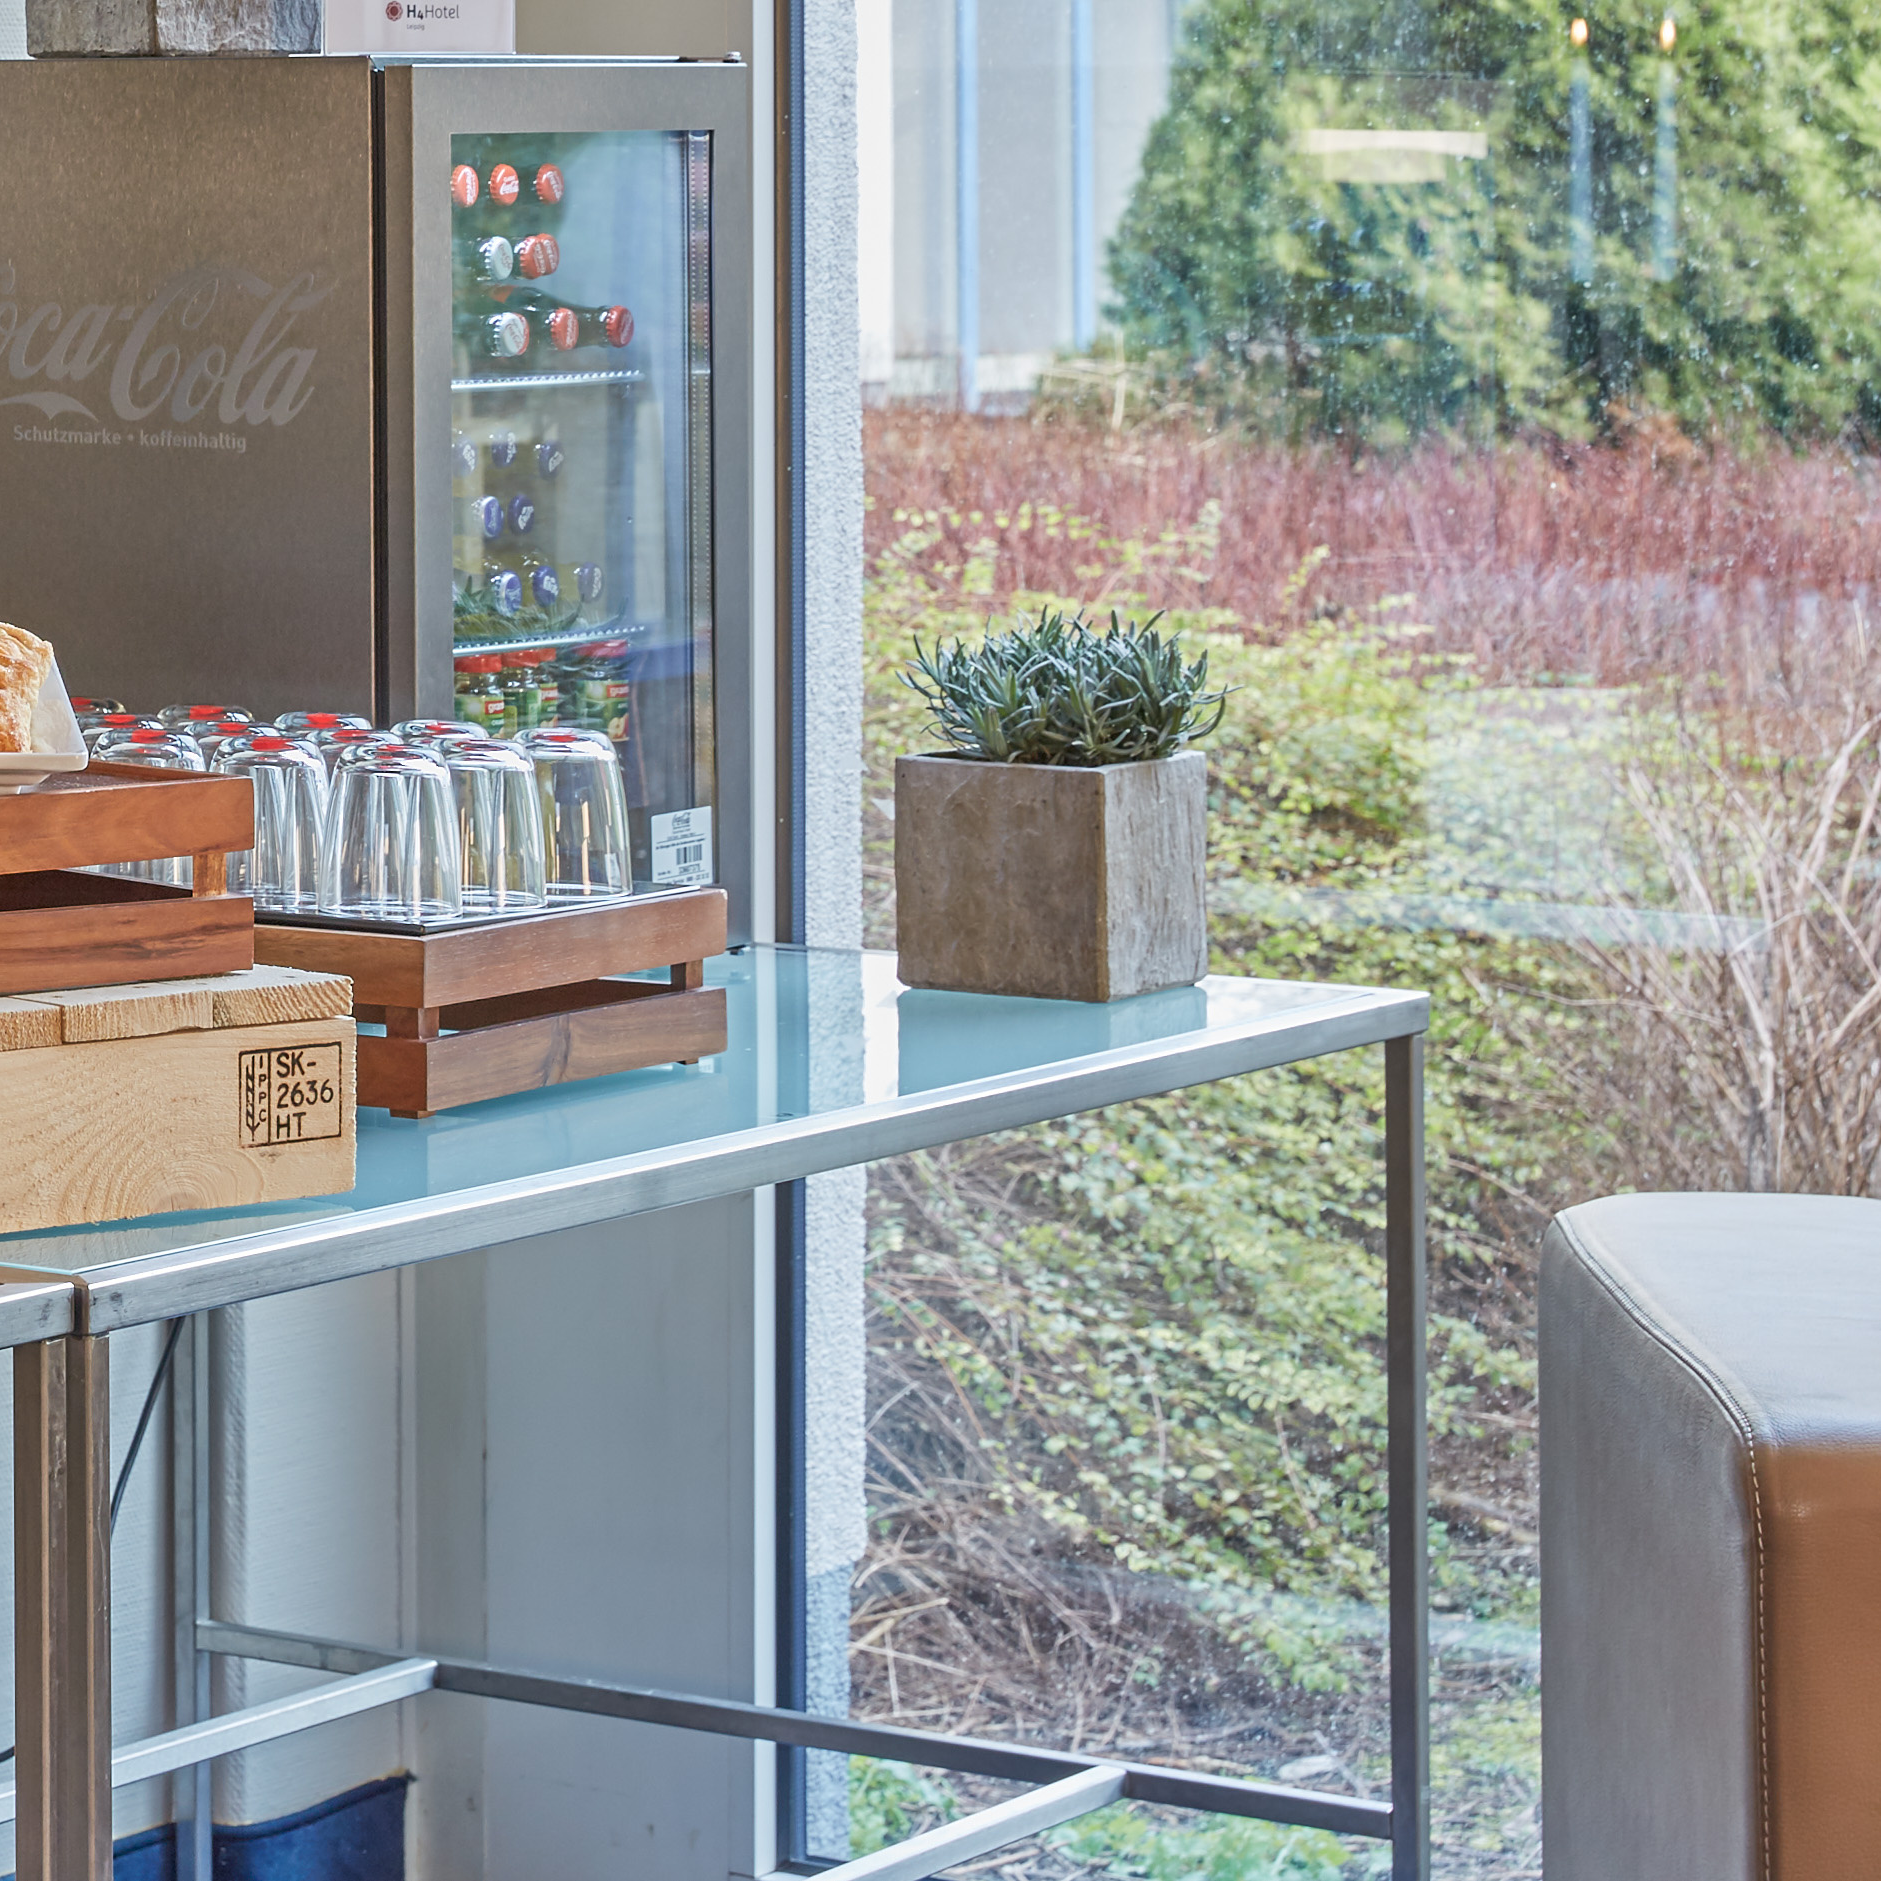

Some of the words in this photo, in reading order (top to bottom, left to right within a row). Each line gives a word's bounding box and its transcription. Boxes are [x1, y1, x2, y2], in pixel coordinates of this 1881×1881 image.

[13, 424, 122, 447] Schutzmarke
[139, 429, 247, 453] koffeinhaltig
[276, 1051, 317, 1079] SK-
[276, 1079, 334, 1109] 2636
[276, 1112, 306, 1139] HT
